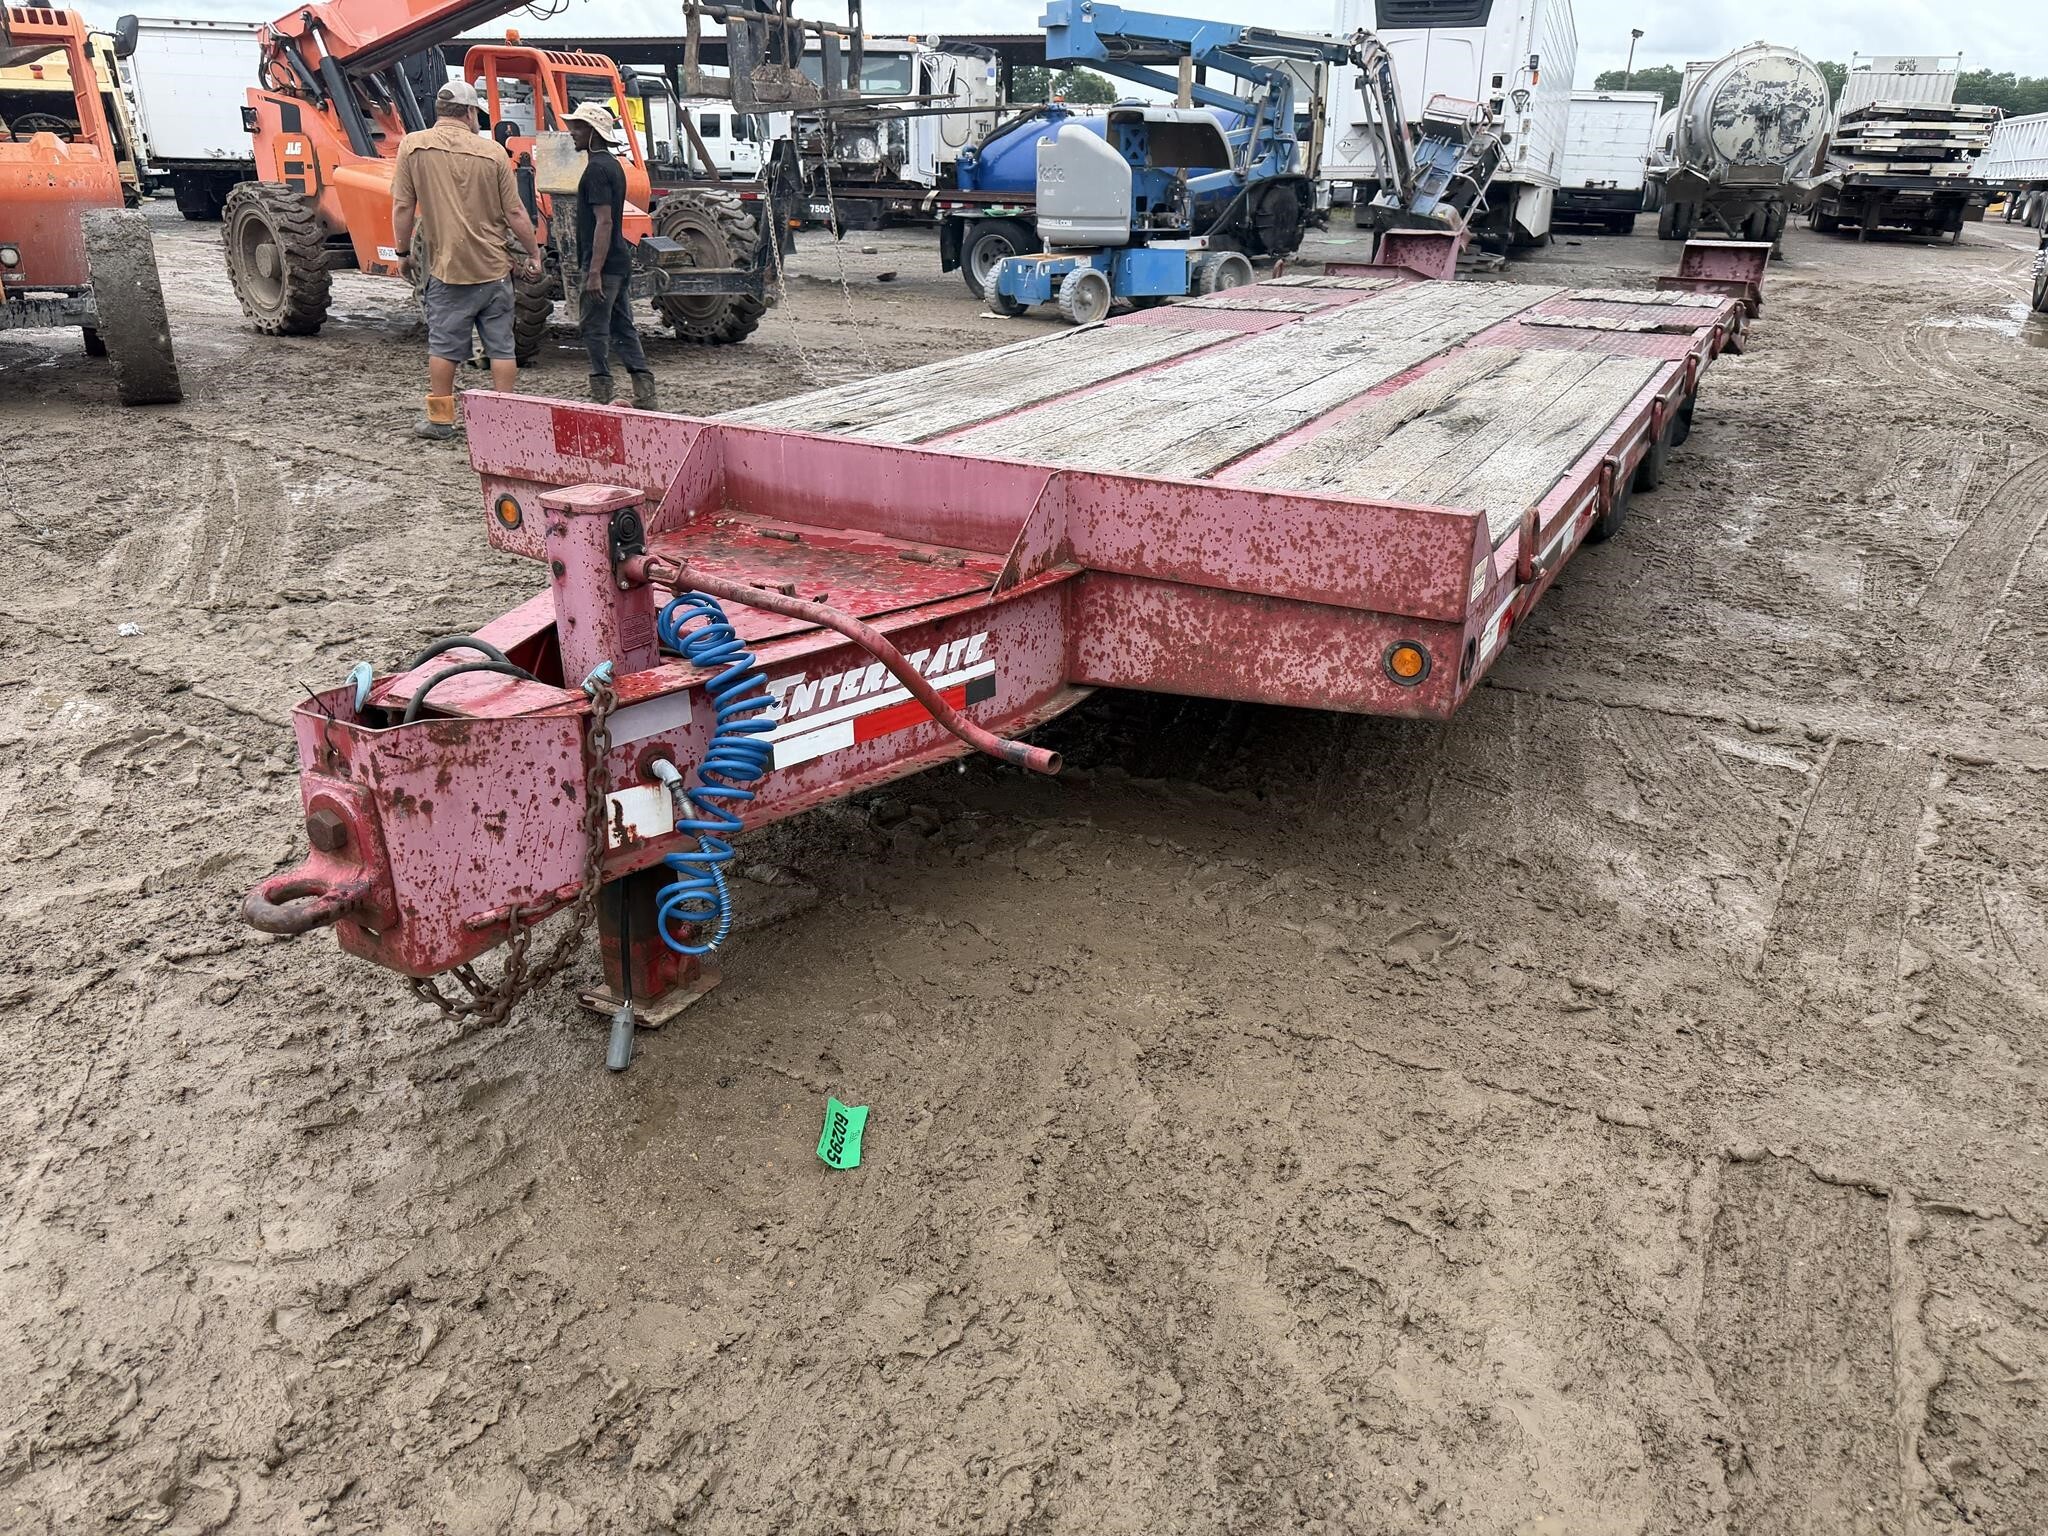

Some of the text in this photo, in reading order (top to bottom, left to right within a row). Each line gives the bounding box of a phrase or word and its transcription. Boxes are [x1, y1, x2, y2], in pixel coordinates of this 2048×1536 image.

[285, 142, 301, 155] JLG
[809, 204, 830, 213] 7503
[827, 1111, 849, 1165] 60295
